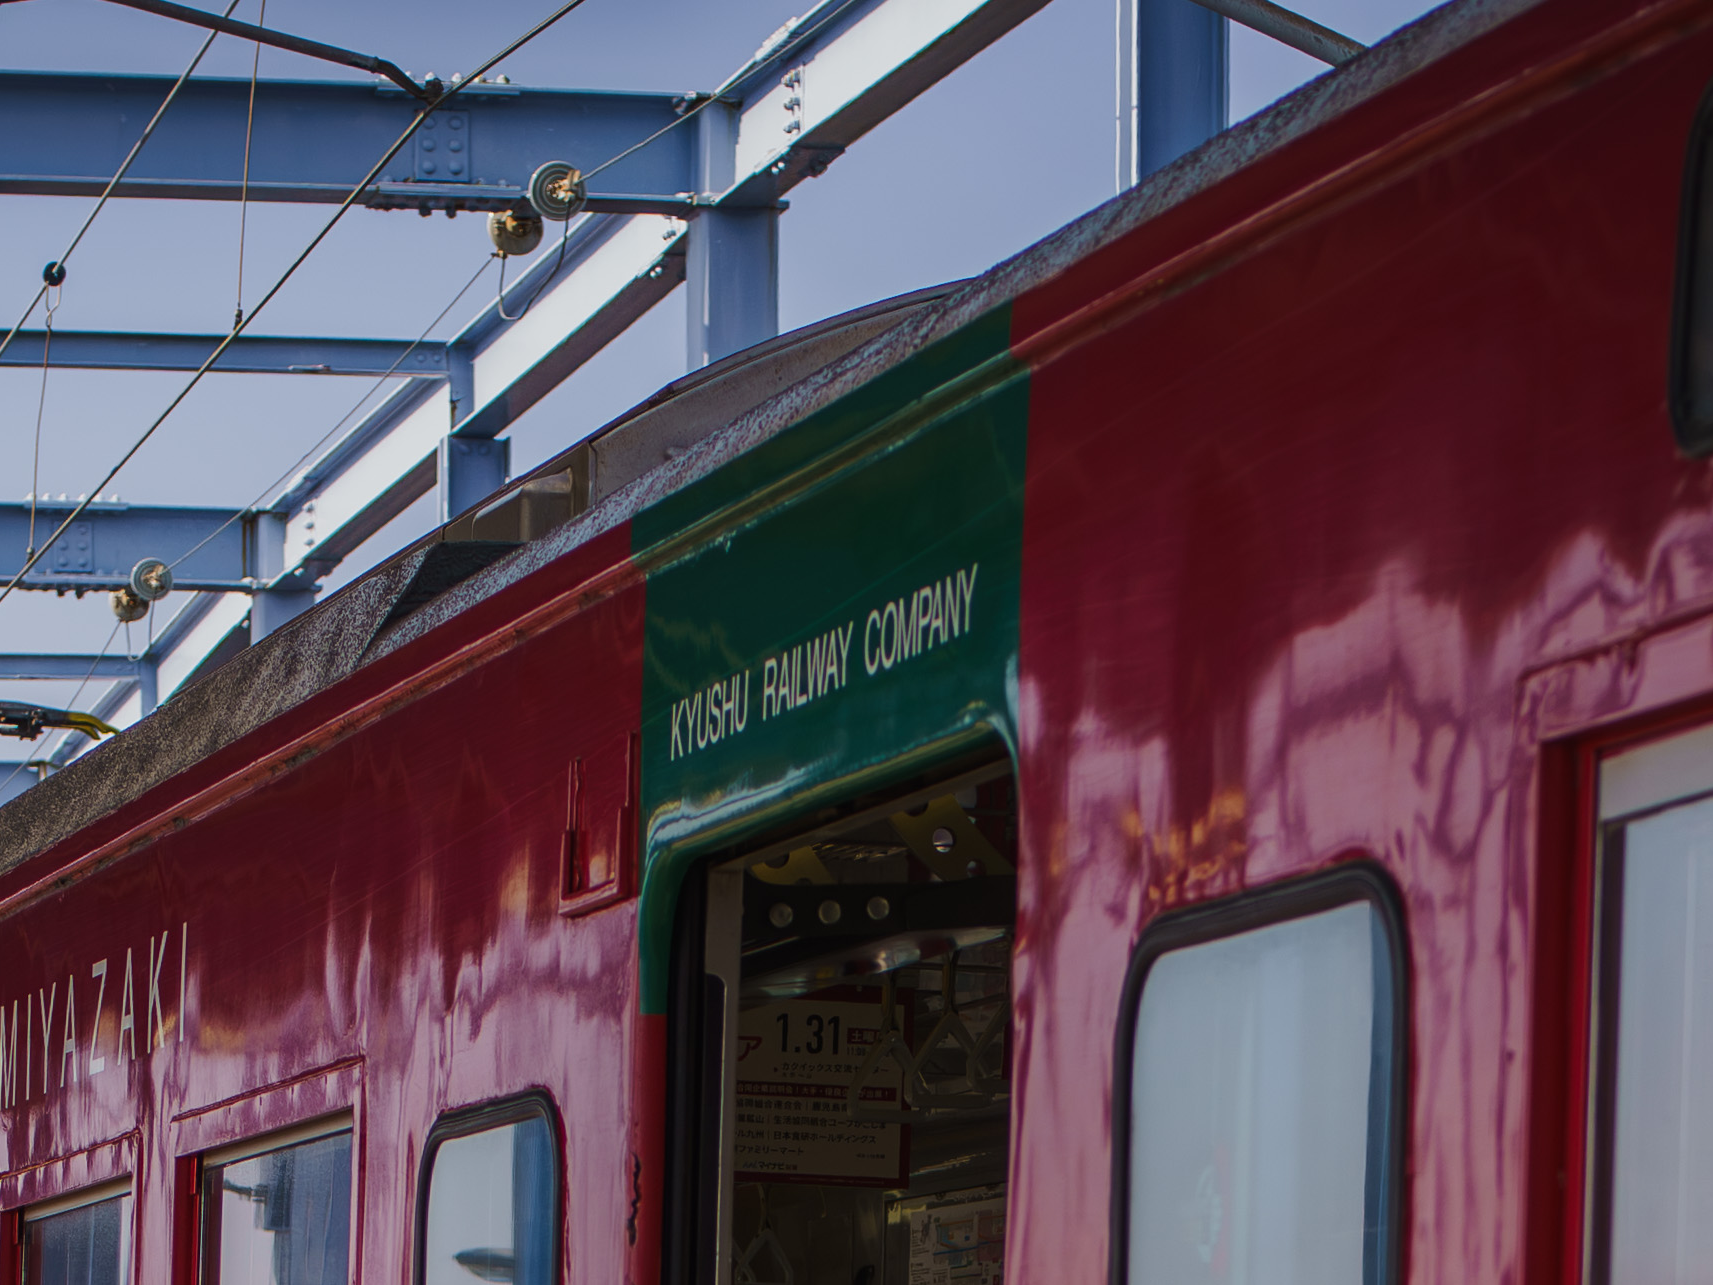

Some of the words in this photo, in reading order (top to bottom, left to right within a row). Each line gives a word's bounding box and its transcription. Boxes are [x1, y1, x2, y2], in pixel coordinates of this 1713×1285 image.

[670, 670, 750, 762] KYUSHU
[762, 620, 855, 722] RAILWAY
[863, 562, 979, 676] COMPANY
[776, 1012, 840, 1056] 1.31
[734, 1145, 804, 1156] ファミリーマート
